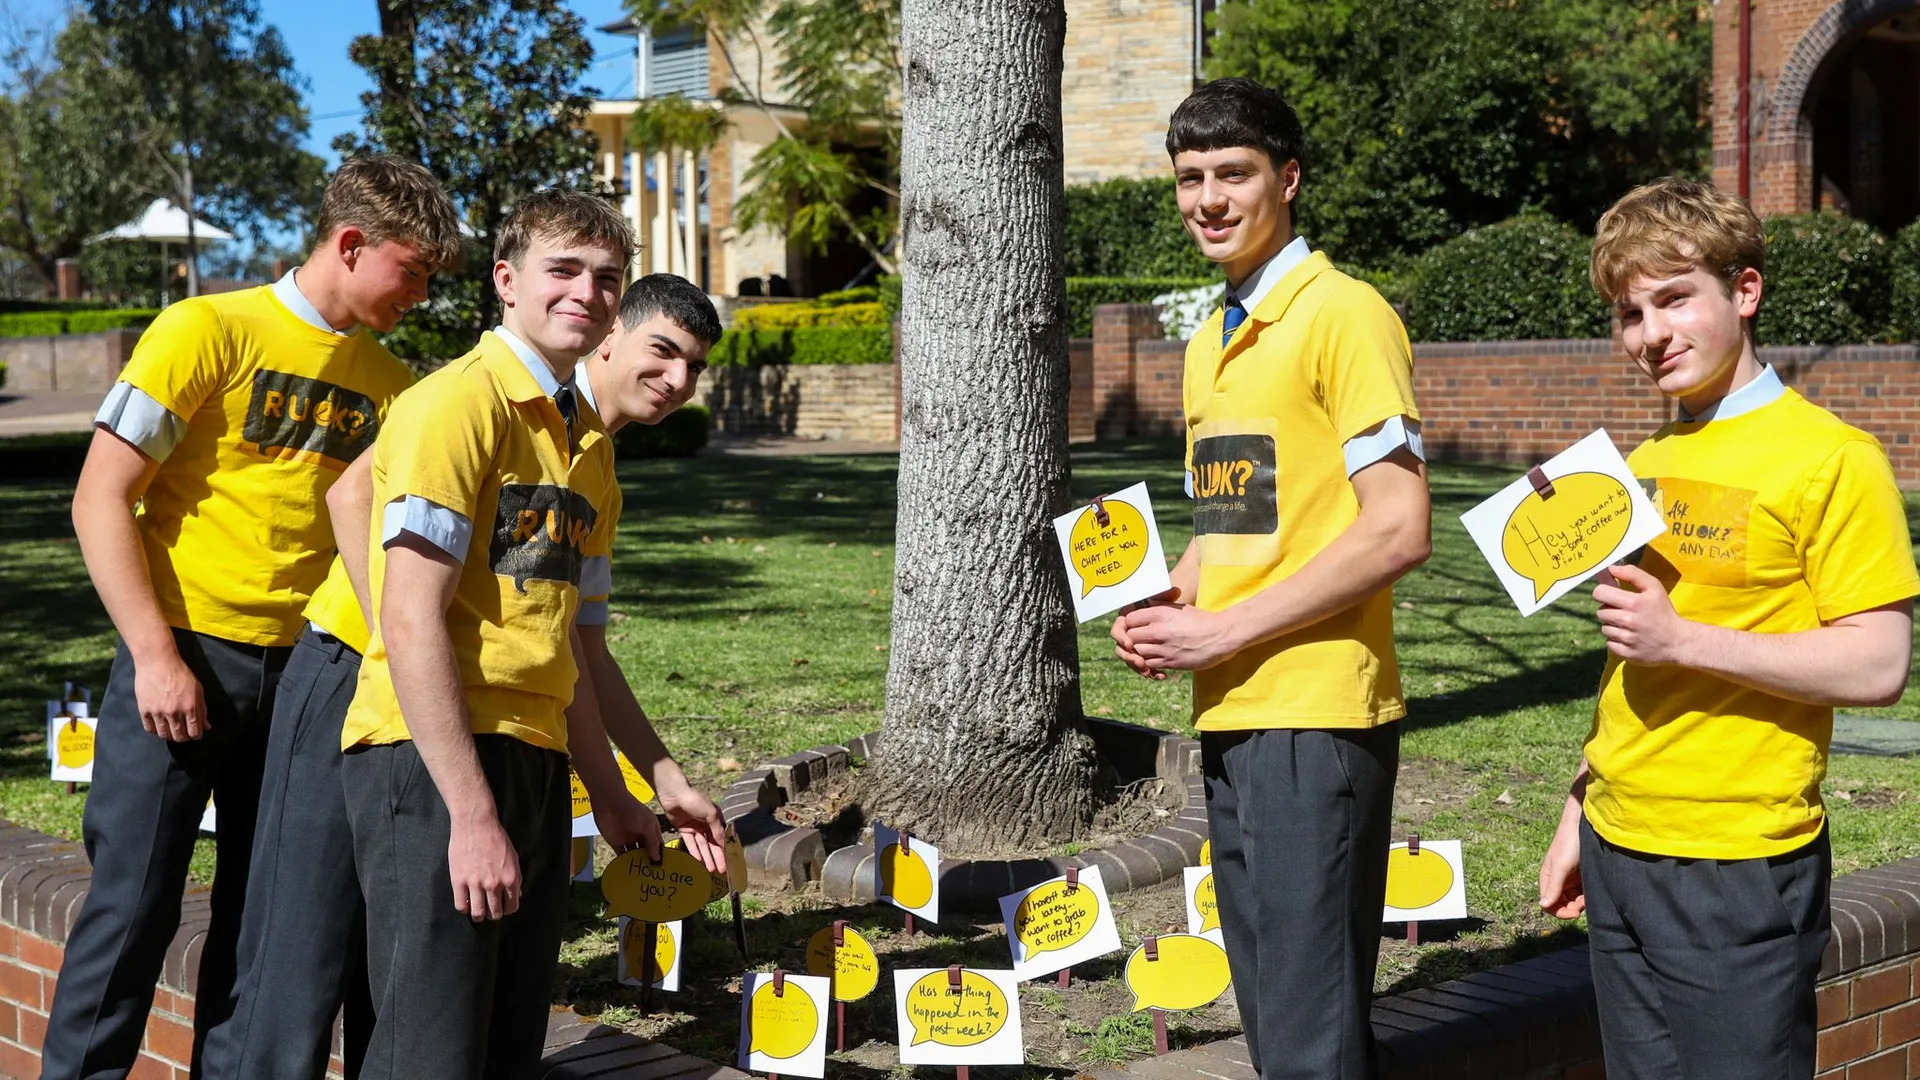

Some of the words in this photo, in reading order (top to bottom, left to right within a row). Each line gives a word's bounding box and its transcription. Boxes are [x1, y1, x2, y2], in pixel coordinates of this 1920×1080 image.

[1511, 516, 1569, 567] Hey
[1569, 514, 1588, 538] you
[1590, 494, 1614, 516] want
[1617, 488, 1626, 499] to
[1551, 548, 1564, 570] get
[1568, 534, 1584, 552] some
[1586, 513, 1613, 536] coffee
[1614, 503, 1629, 517] and
[1074, 537, 1097, 553] HERE
[1100, 526, 1119, 541] FOR
[1121, 524, 1128, 533] A
[1081, 552, 1101, 569] CHAT
[1104, 546, 1115, 559] IF
[1679, 542, 1706, 556] ANY
[1095, 560, 1123, 577] NEED.
[628, 857, 666, 881] How
[669, 874, 694, 887] are
[1026, 902, 1032, 913] I
[1018, 915, 1036, 933] you
[1027, 922, 1050, 937] want
[1053, 918, 1063, 926] to
[1064, 908, 1087, 928] grab
[1035, 938, 1043, 947] a
[919, 985, 938, 998] Has
[913, 1003, 965, 1023] happened
[968, 1010, 983, 1018] in
[984, 1006, 1000, 1019] the
[930, 1022, 954, 1038] past
